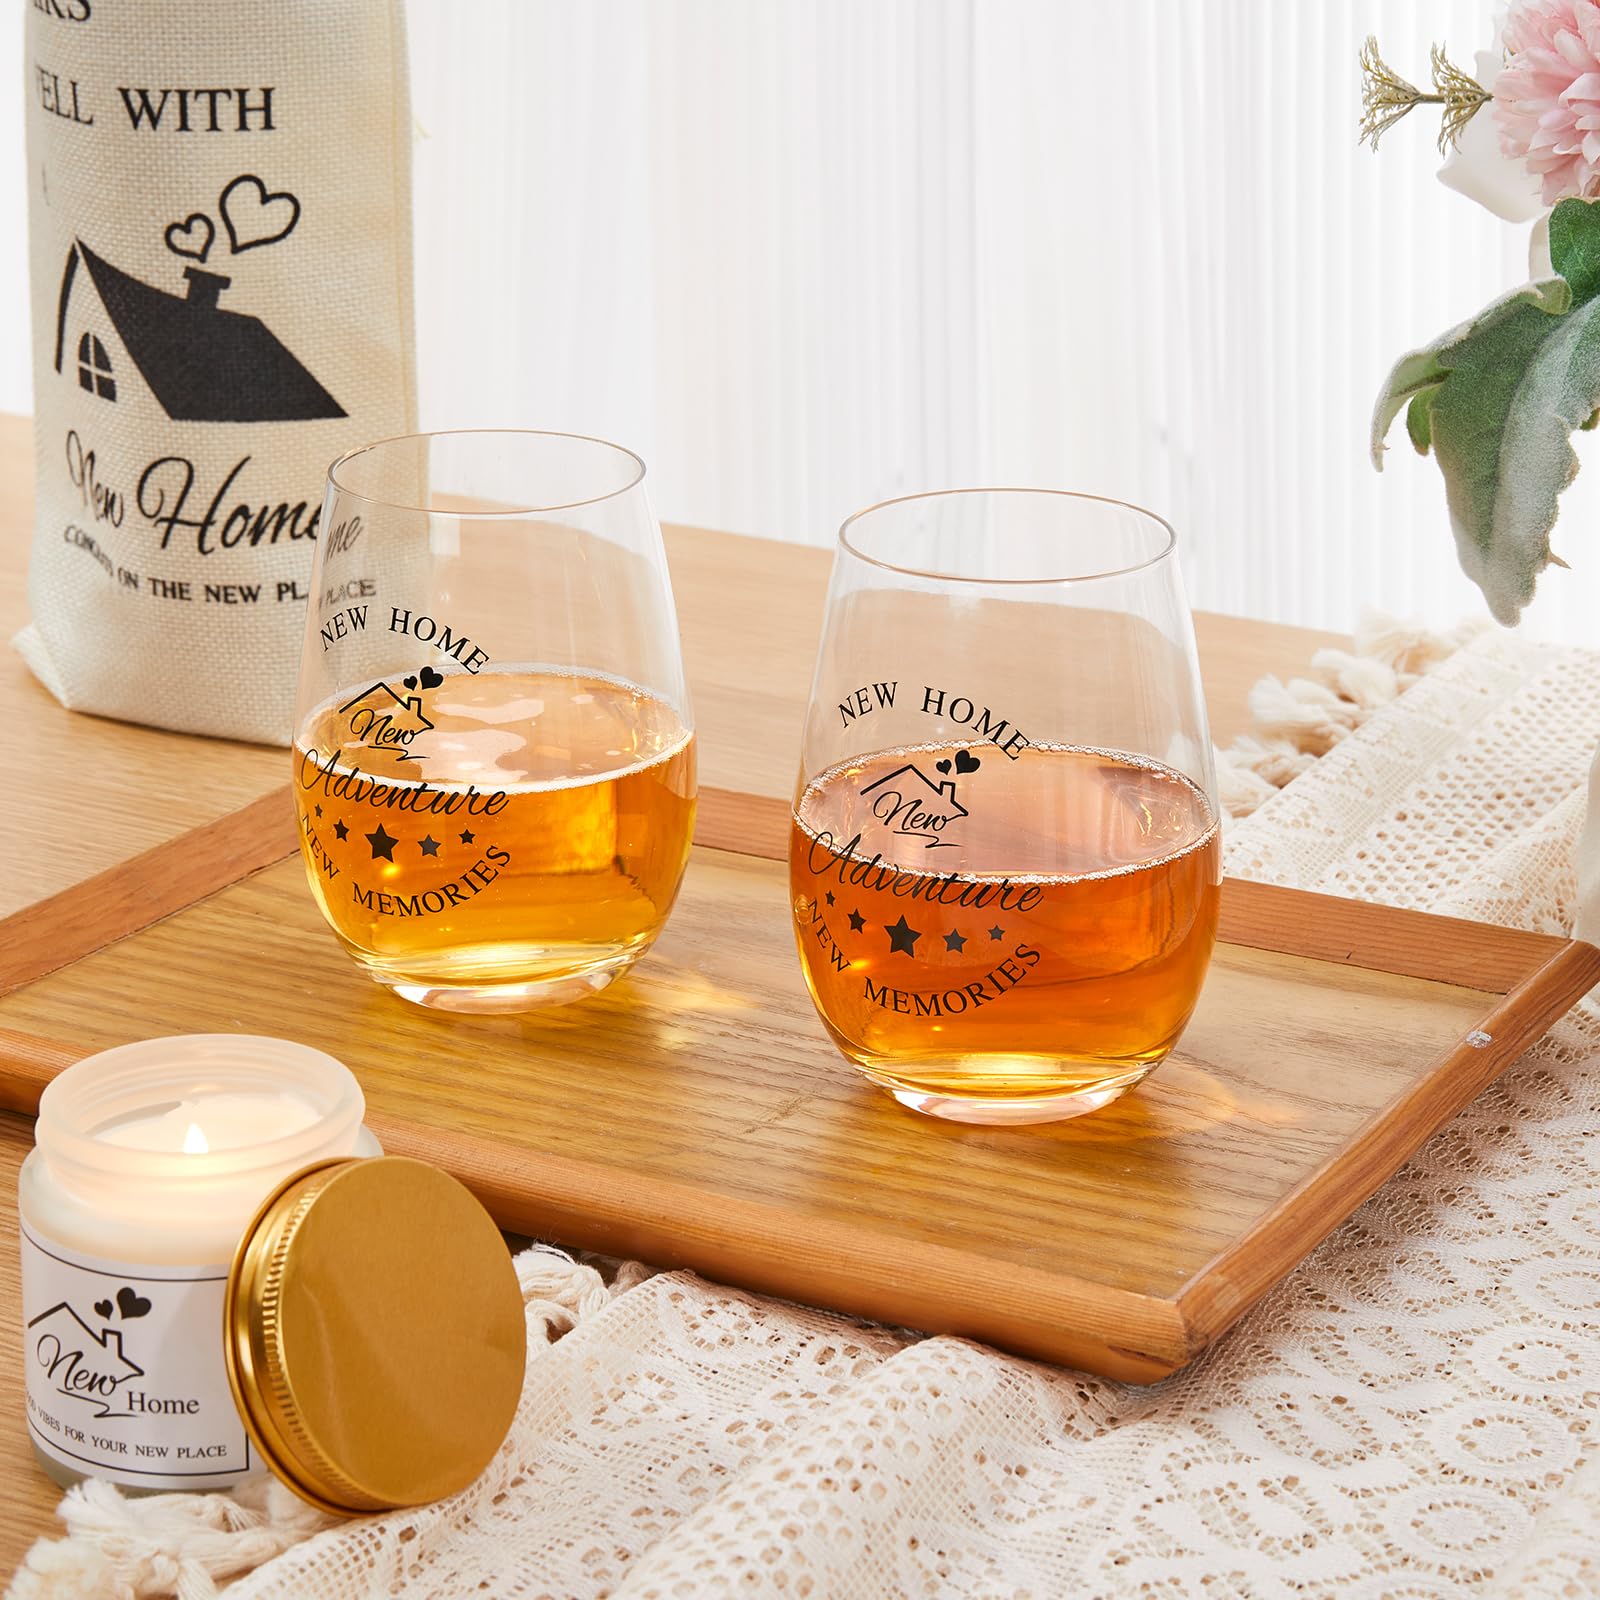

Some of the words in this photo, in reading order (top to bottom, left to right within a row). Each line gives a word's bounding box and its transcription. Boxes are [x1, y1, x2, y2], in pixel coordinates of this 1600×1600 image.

[36, 65, 93, 125] ELL
[117, 87, 277, 132] WITH
[66, 430, 124, 528] New
[137, 455, 321, 555] Home
[64, 525, 113, 577] CONS
[118, 567, 139, 590] ON
[147, 577, 192, 601] THE
[205, 584, 262, 604] NEW
[320, 605, 369, 652] NEW
[388, 606, 490, 675] HOME
[350, 708, 416, 746] New
[838, 681, 898, 728] NEW
[920, 686, 1031, 761] HOME
[301, 749, 509, 816] Adventure
[872, 791, 948, 832] New
[302, 814, 341, 880] NEW
[352, 845, 511, 917] MEMORIES
[808, 831, 1044, 912] Adventure
[808, 897, 852, 973] NEW
[863, 943, 1041, 1018] MEMORIES
[37, 1334, 118, 1396] New
[127, 1390, 200, 1415] Home
[38, 1405, 60, 1432] VIBES
[64, 1424, 86, 1444] FOR
[91, 1435, 128, 1455] YOUR
[135, 1445, 169, 1459] NEW
[177, 1444, 227, 1460] PLACE
